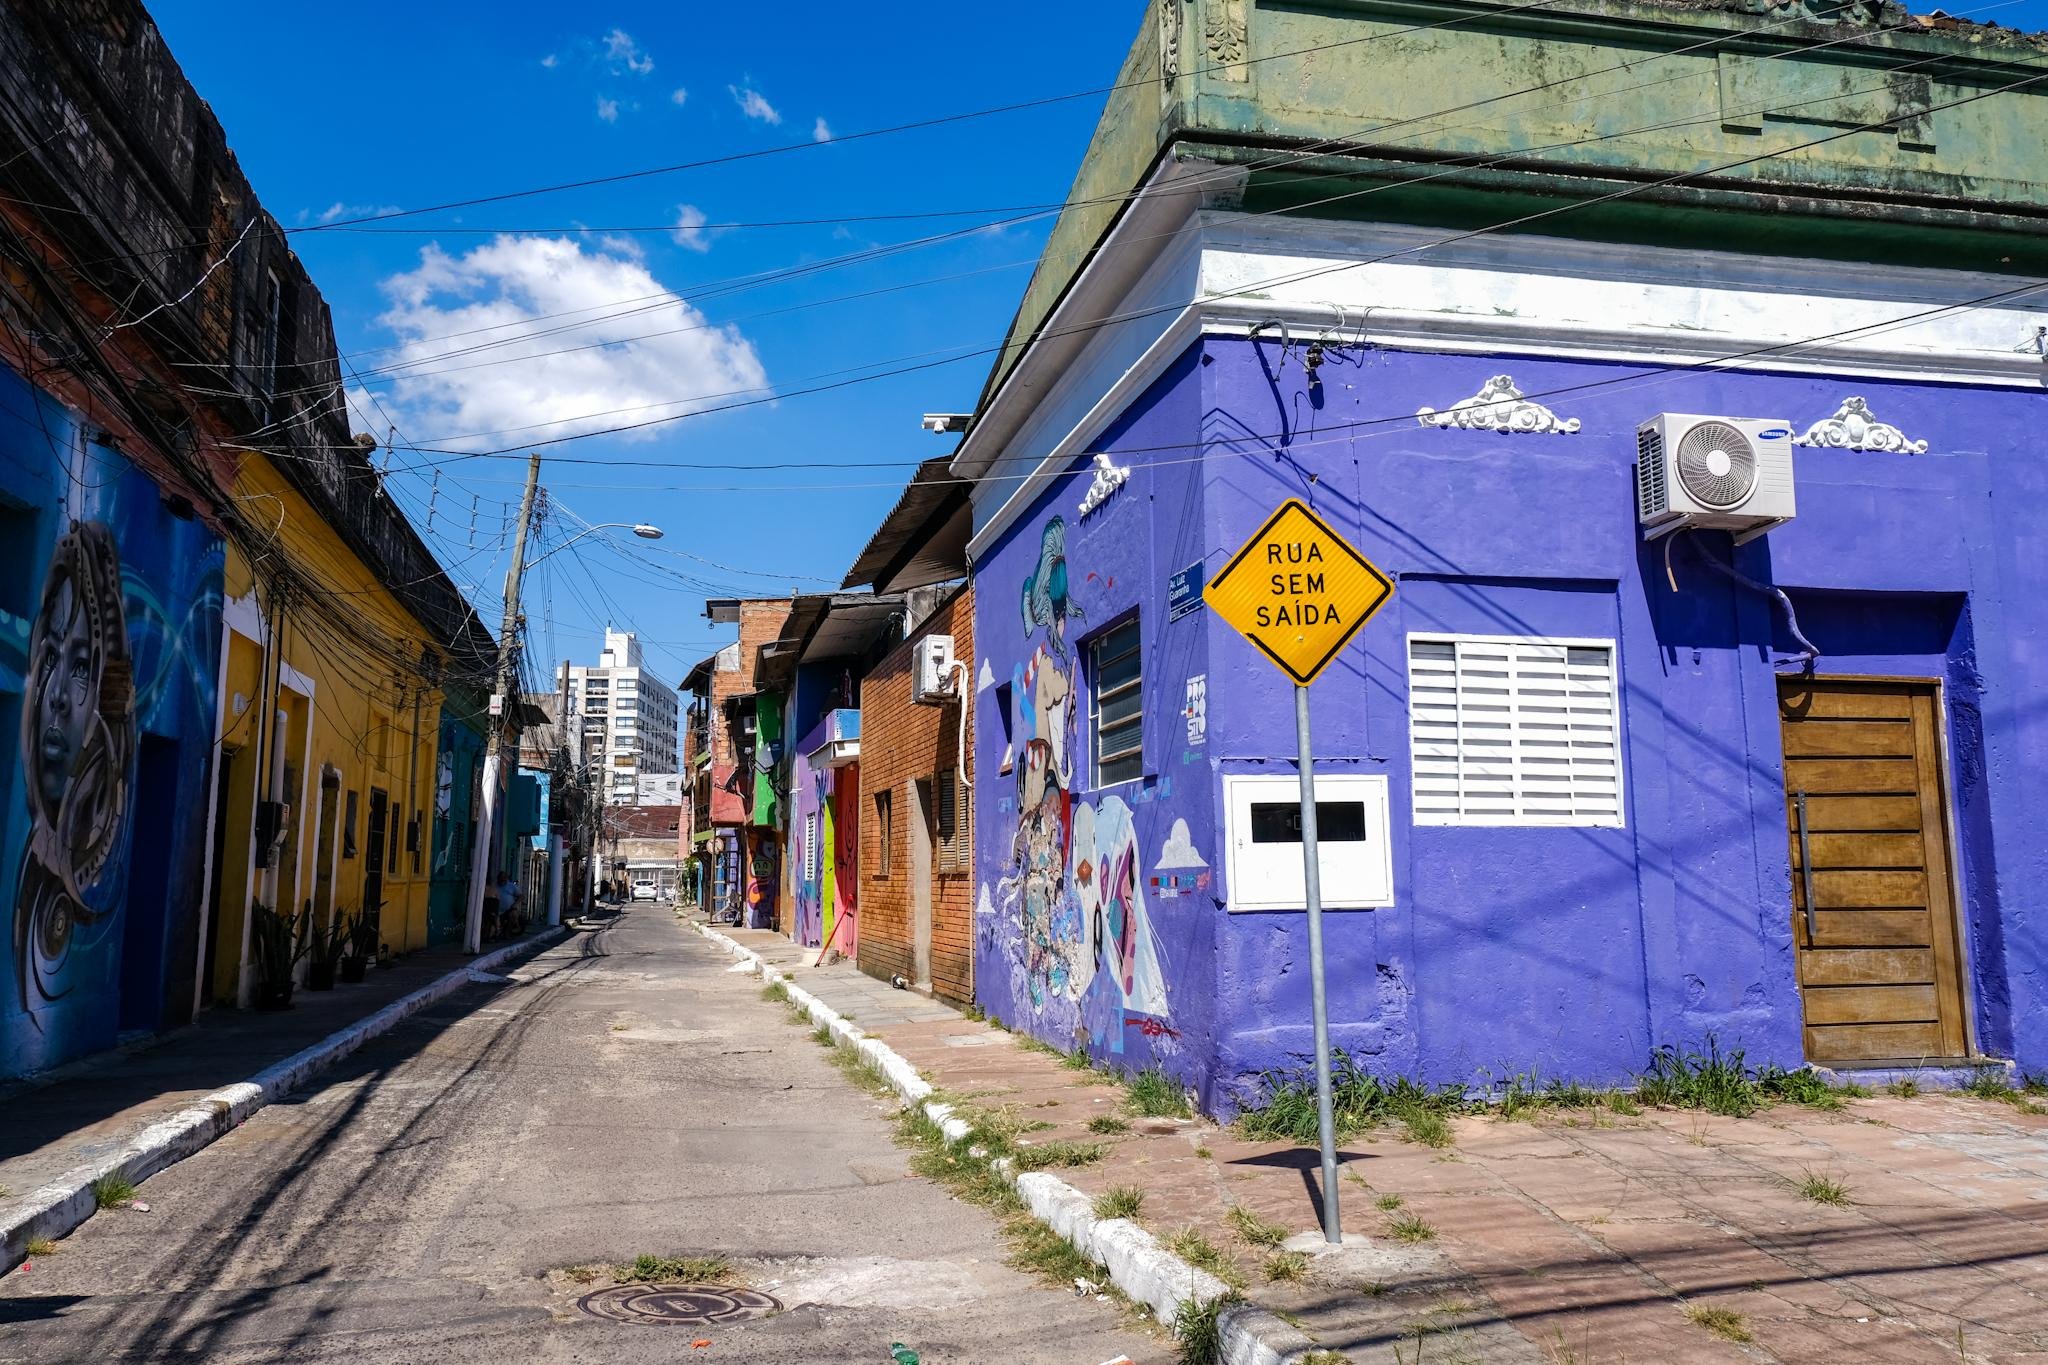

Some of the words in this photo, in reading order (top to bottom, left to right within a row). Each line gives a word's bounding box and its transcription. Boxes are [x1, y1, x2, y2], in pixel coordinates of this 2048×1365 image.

[1761, 430, 1786, 438] SAMSUNG
[1267, 542, 1323, 564] RUA
[1176, 573, 1186, 587] Luiz
[1271, 573, 1325, 595] SEM
[1256, 600, 1341, 627] SAÍDA
